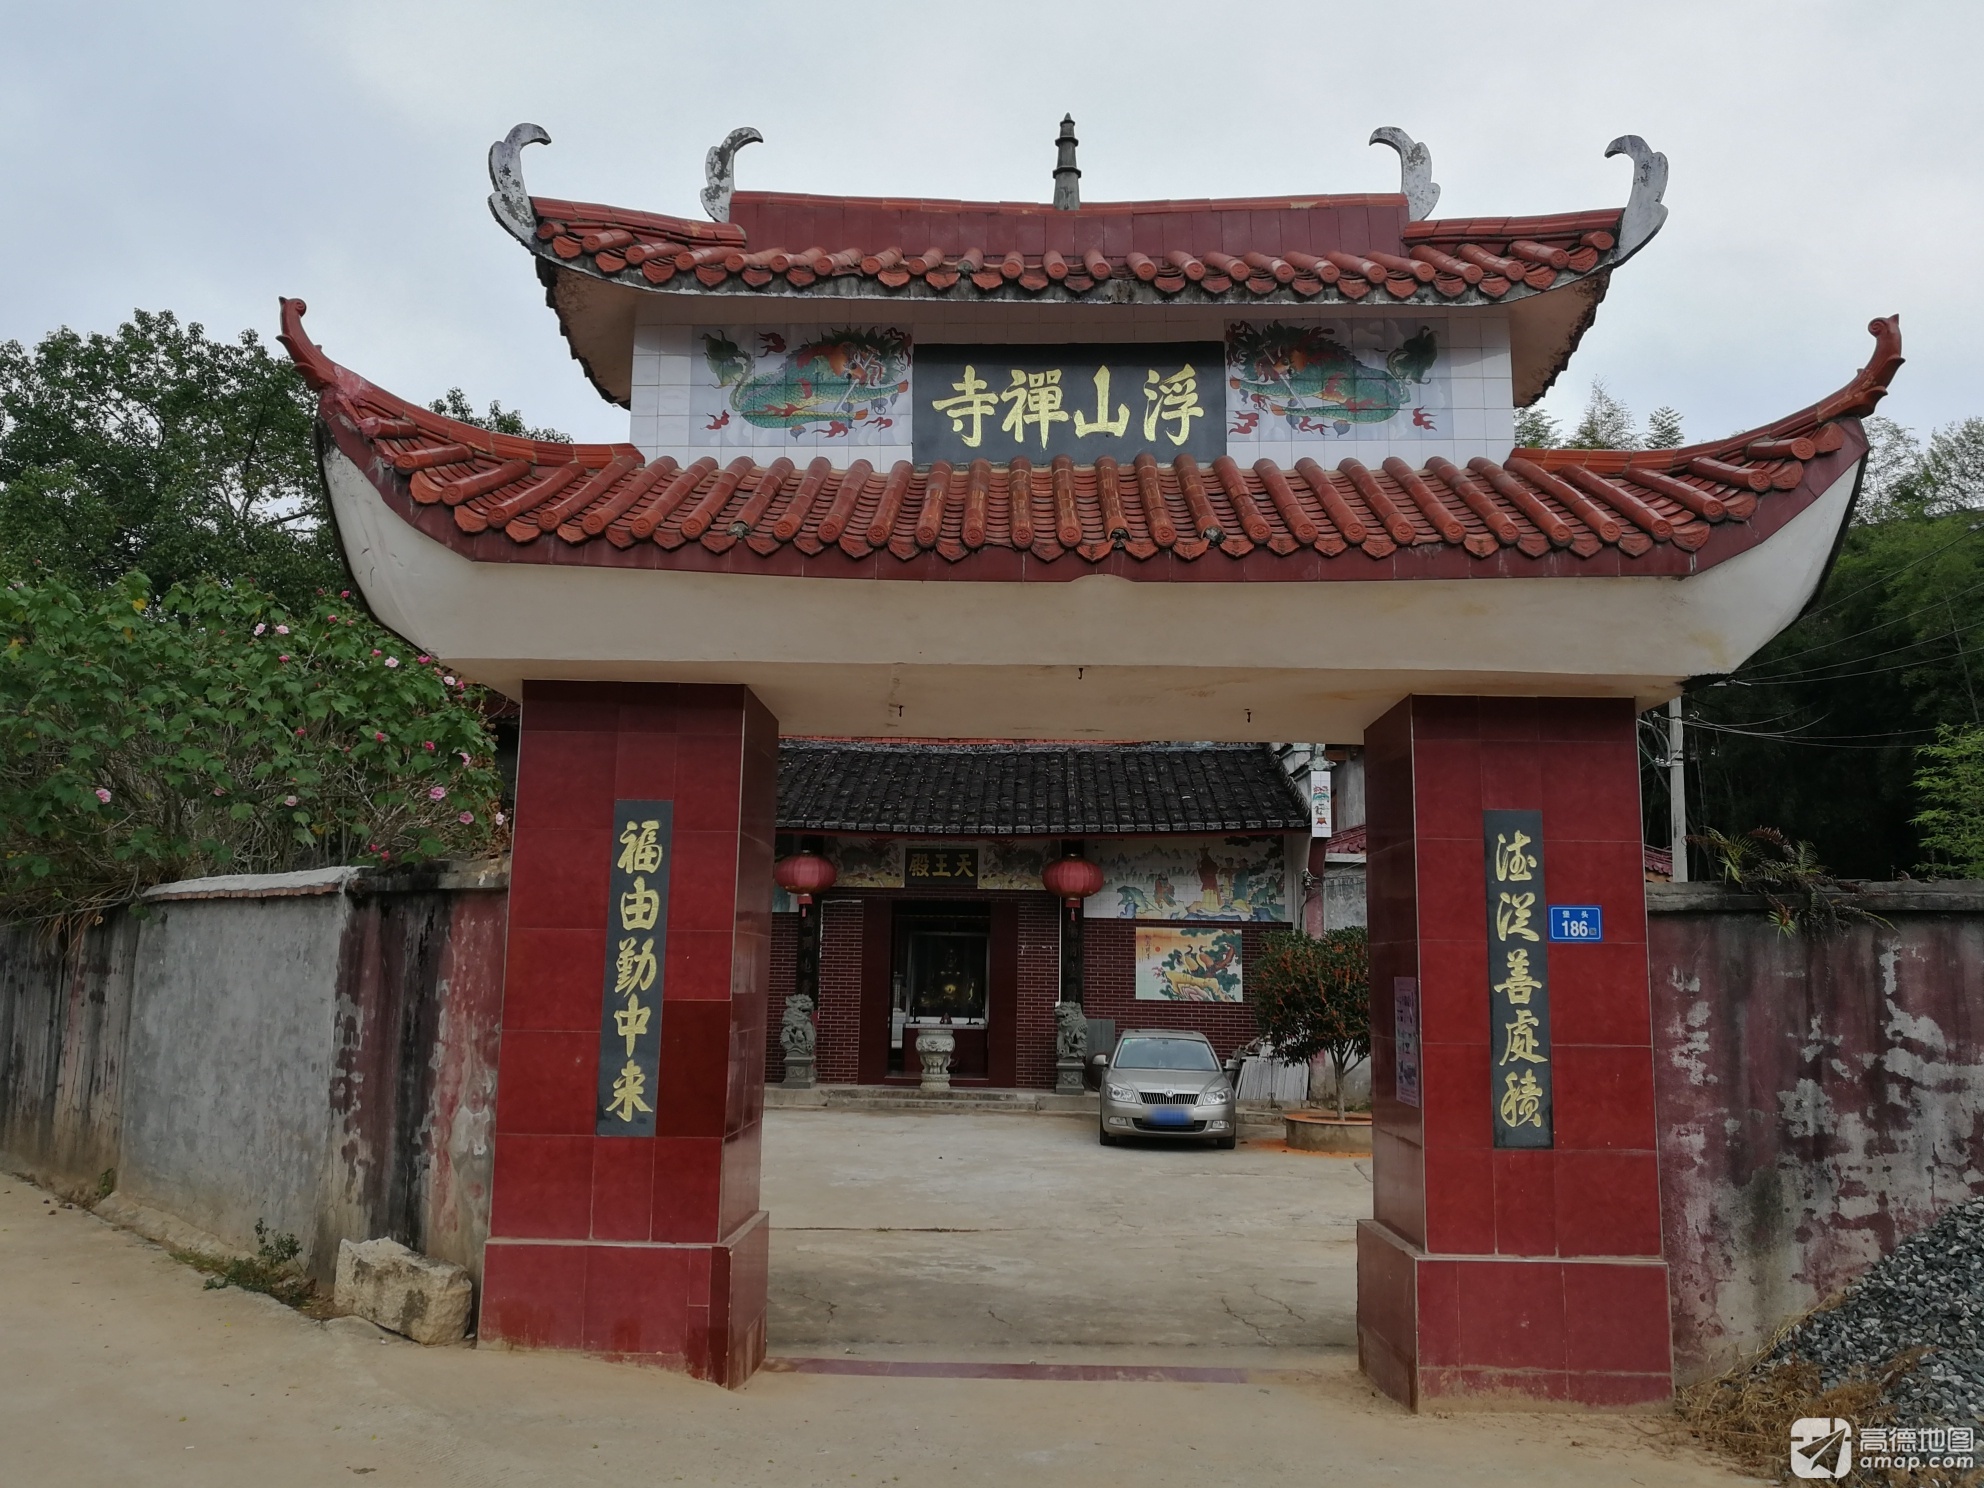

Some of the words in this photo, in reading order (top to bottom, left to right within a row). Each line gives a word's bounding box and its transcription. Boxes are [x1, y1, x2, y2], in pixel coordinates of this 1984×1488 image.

[908, 853, 975, 878] 天王殿
[1561, 920, 1589, 937] 186
